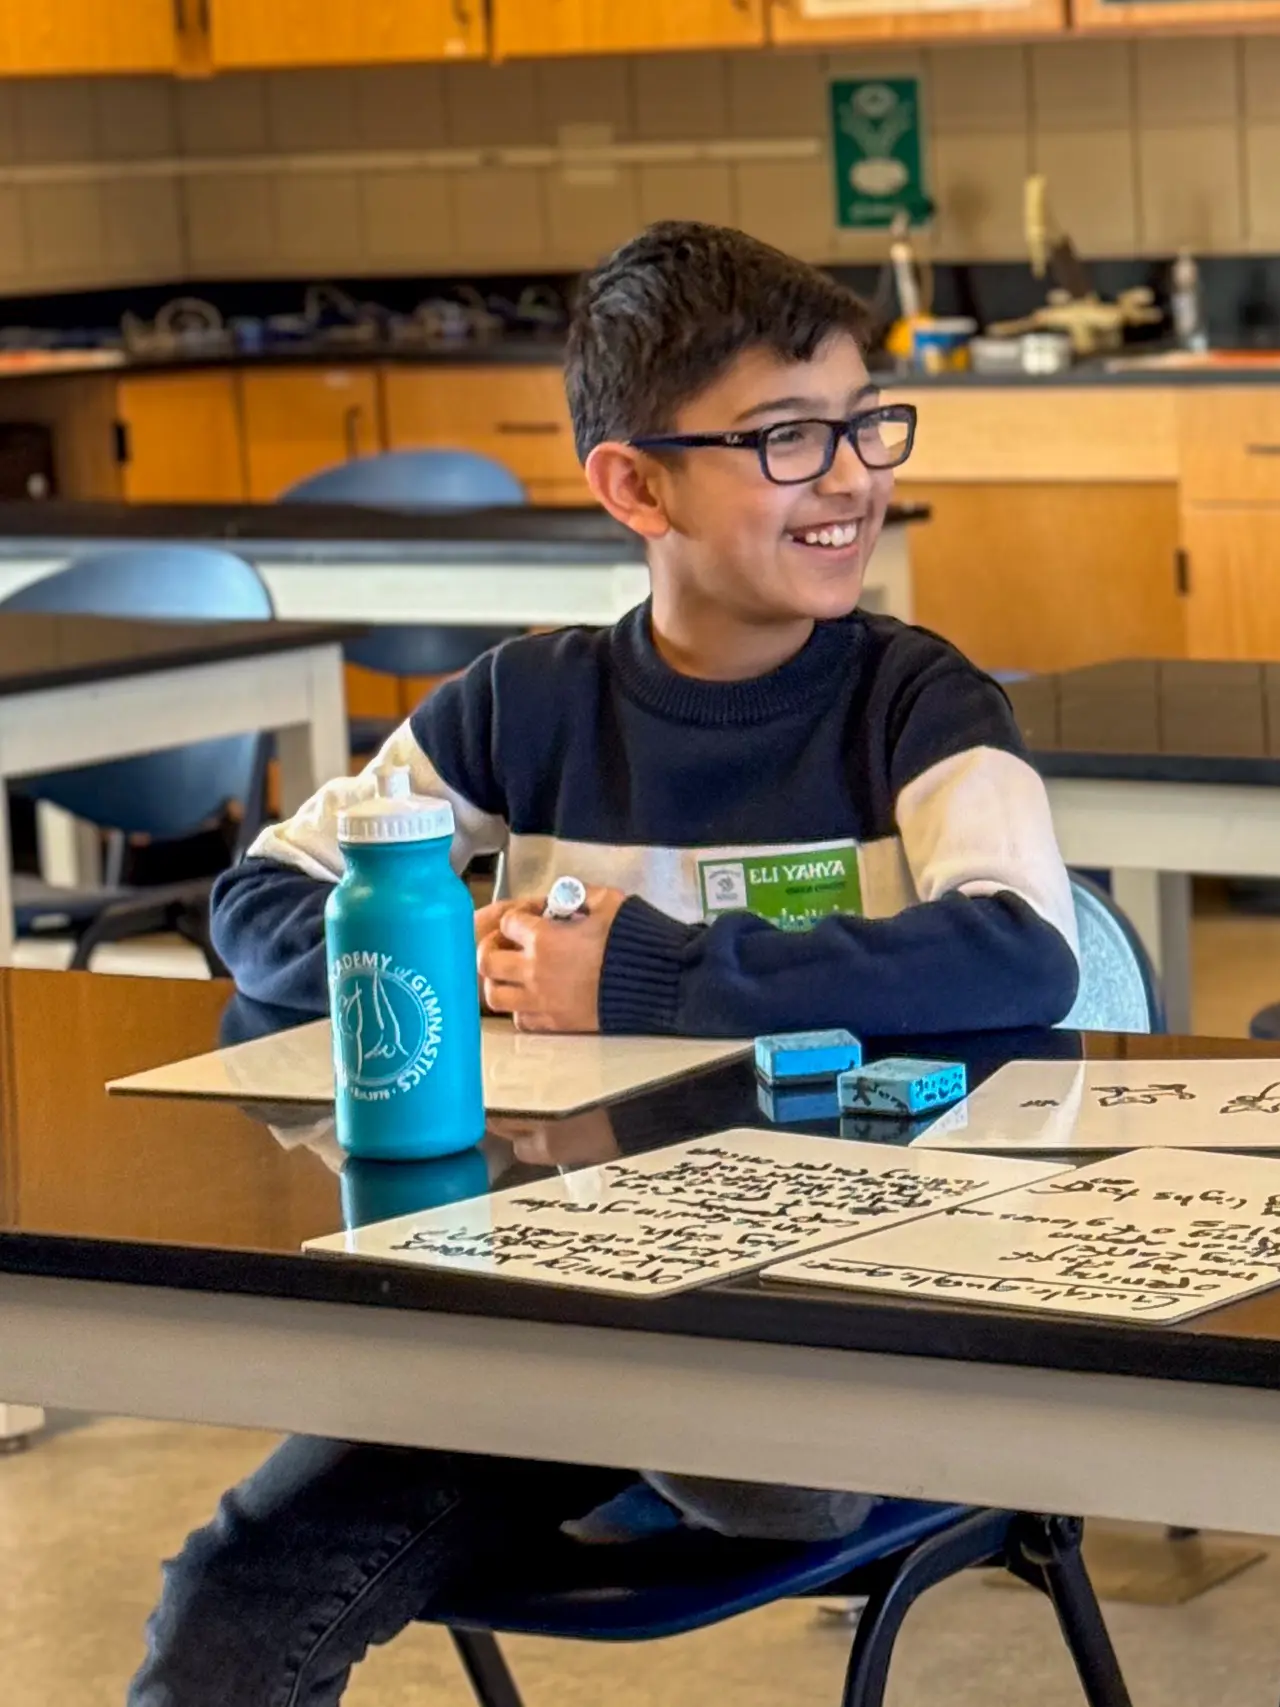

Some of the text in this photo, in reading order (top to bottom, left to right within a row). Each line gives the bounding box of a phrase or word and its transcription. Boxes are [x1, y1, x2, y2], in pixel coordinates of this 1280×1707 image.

[749, 859, 846, 884] ELI YAHYA
[397, 975, 443, 1092] GYMNASTICS
